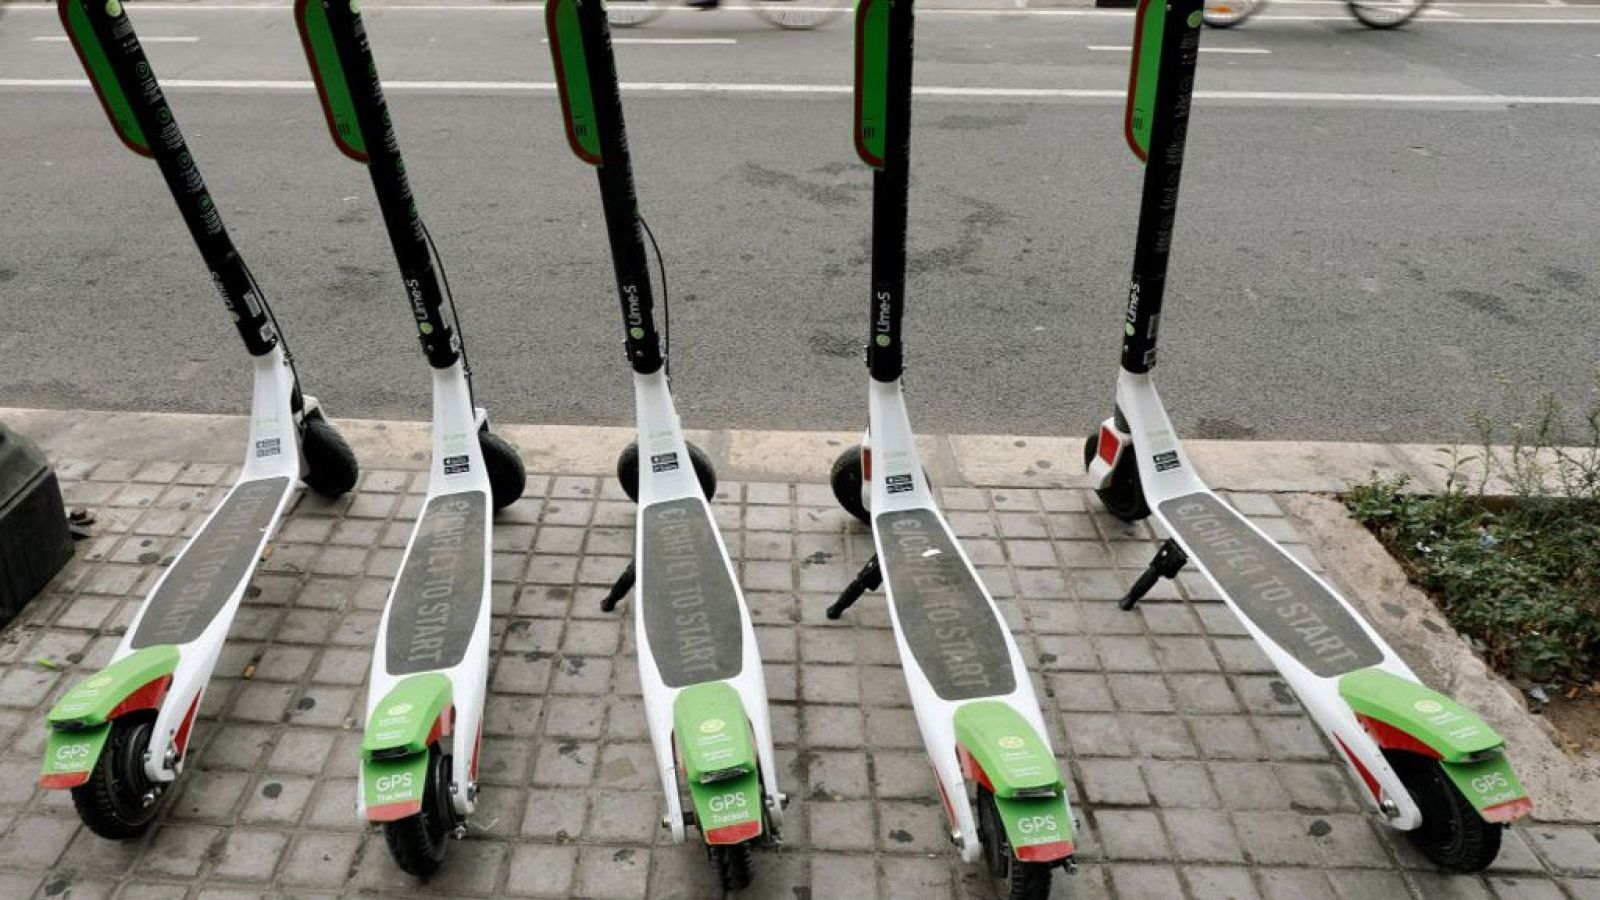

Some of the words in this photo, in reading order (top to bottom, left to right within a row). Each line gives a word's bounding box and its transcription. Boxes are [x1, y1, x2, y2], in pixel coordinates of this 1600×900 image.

[421, 575, 456, 599] TO
[670, 582, 705, 609] TO
[1250, 576, 1293, 601] TO
[1276, 602, 1359, 662] START
[407, 601, 451, 664] START
[675, 611, 718, 673] START
[935, 626, 991, 688] START
[56, 743, 91, 760] GPS
[375, 772, 413, 793] GPS
[1471, 771, 1509, 793] GPS
[708, 791, 747, 812] GPS
[1018, 815, 1058, 834] GPS
